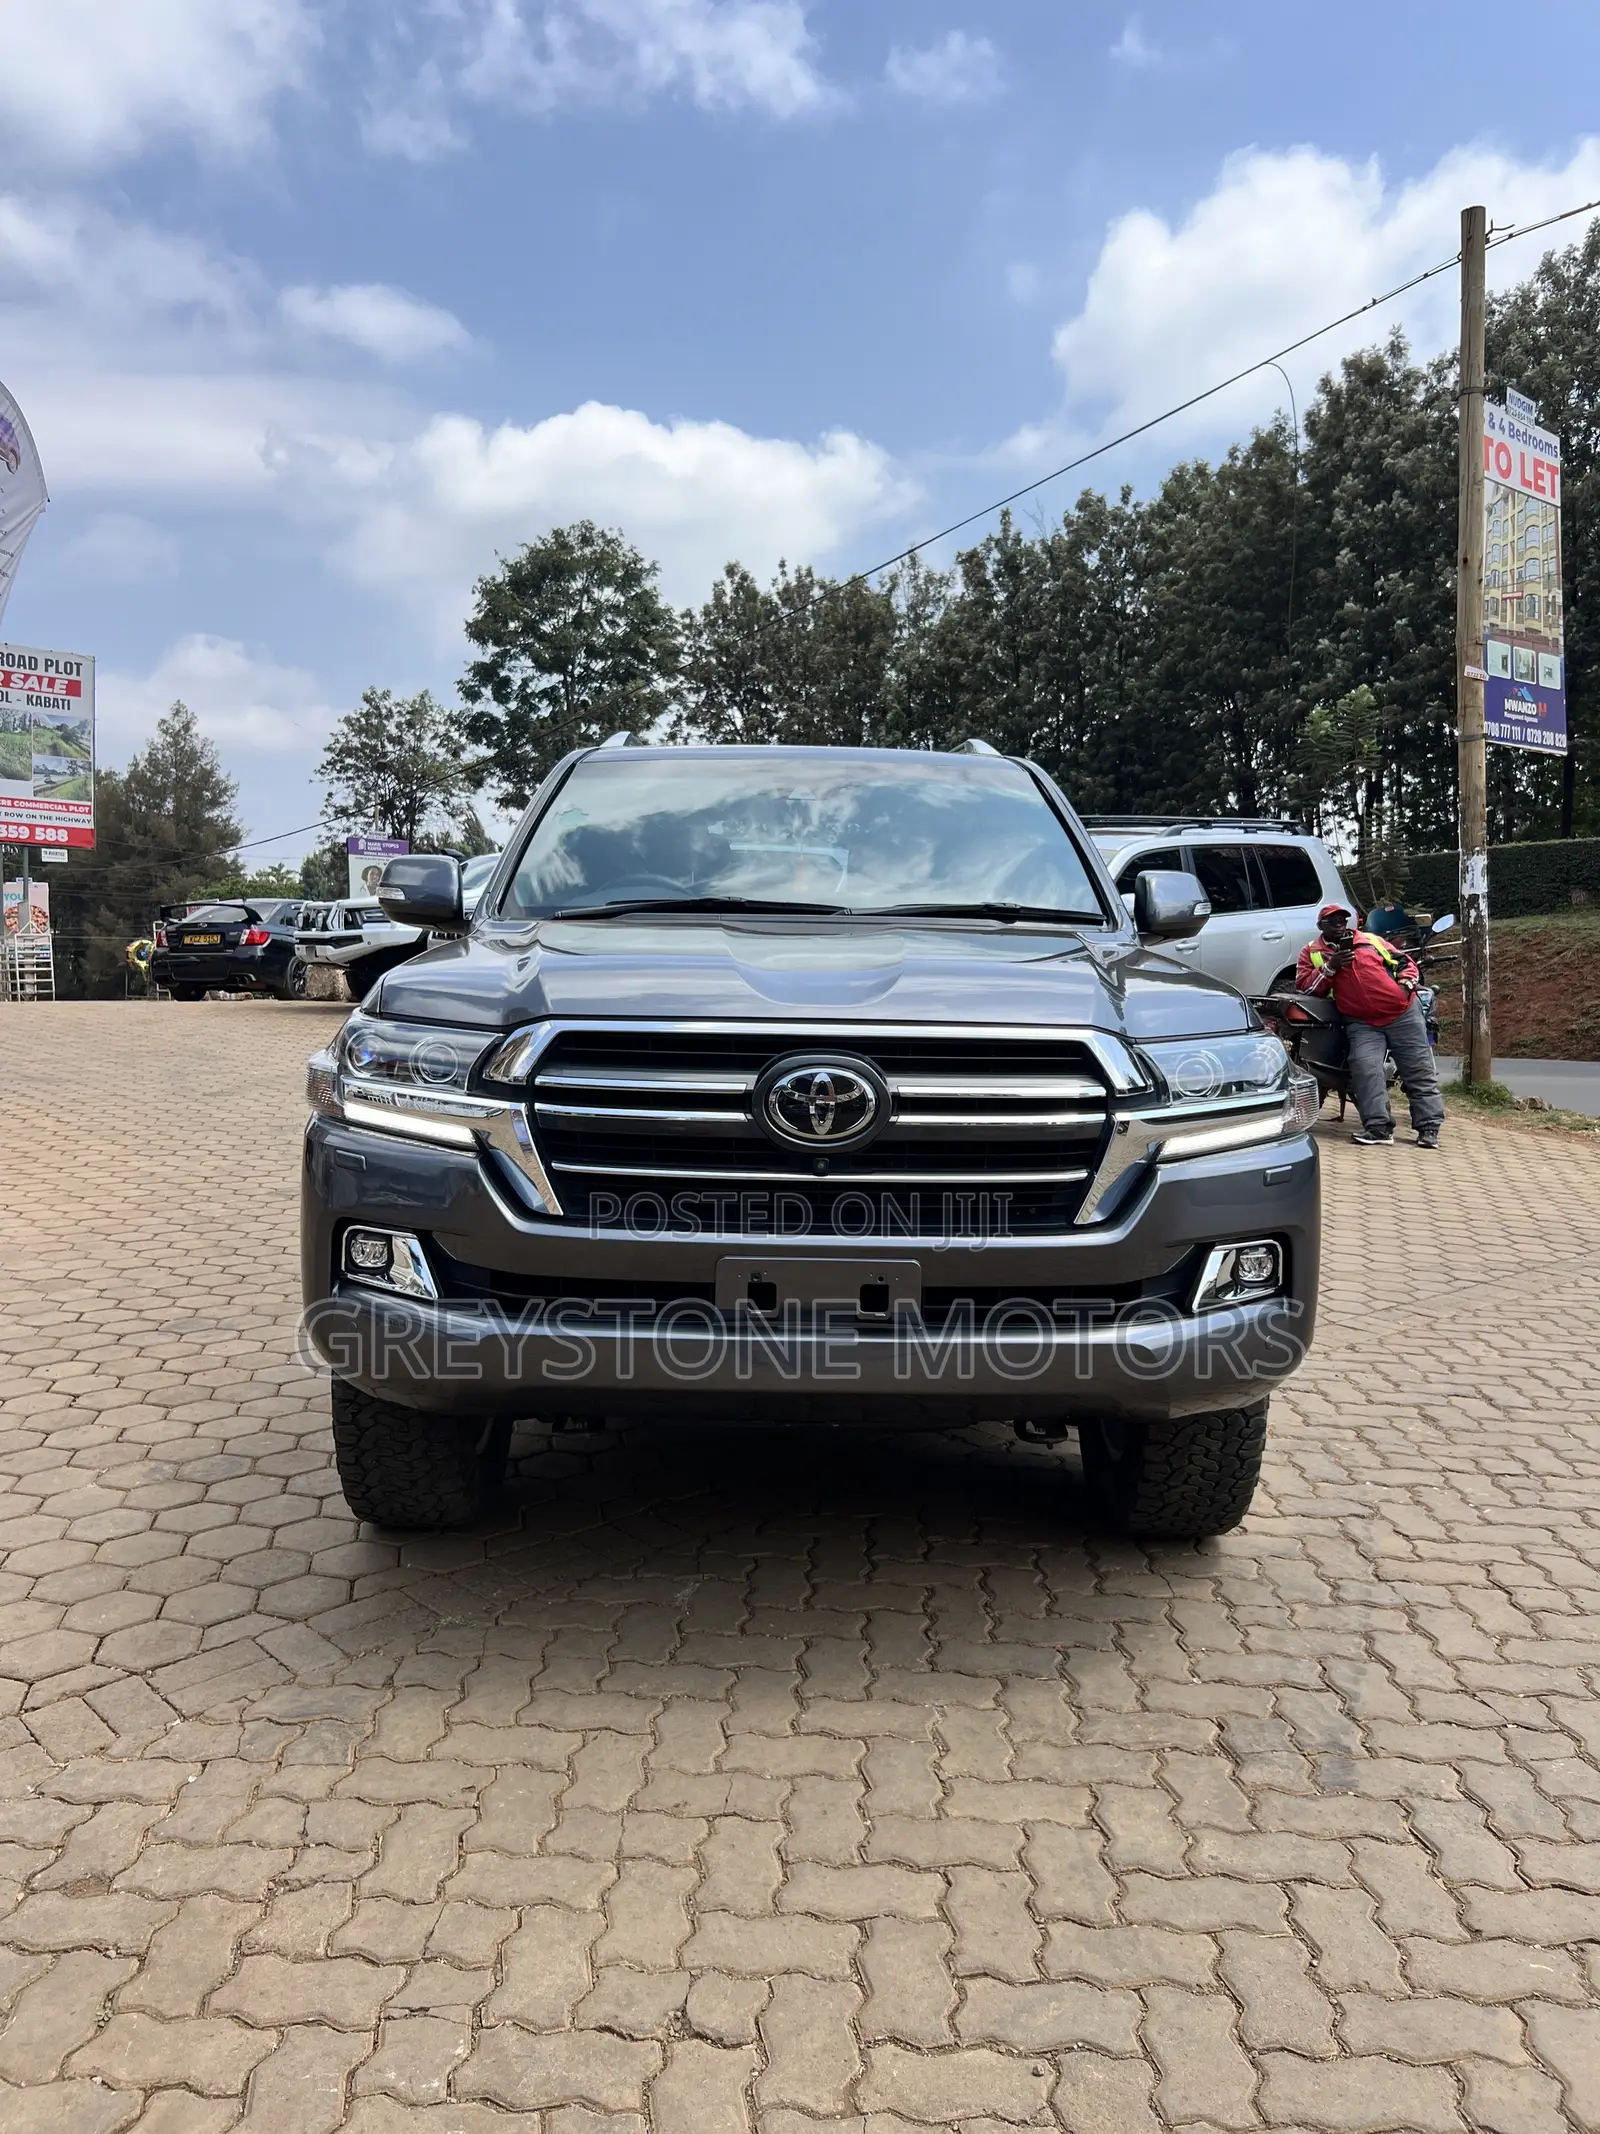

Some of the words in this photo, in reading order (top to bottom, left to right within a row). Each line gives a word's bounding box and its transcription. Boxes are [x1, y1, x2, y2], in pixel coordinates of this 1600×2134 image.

[1499, 417, 1506, 435] 4
[1508, 421, 1559, 459] Bedrooms
[1484, 435, 1512, 480] TO
[1520, 451, 1559, 499] LET
[44, 658, 83, 677] PLOT
[9, 672, 69, 695] SALE
[26, 693, 71, 711] KABATI
[1504, 698, 1537, 716] MWANZO
[1501, 724, 1510, 739] 777
[1512, 725, 1521, 741] 111
[1527, 728, 1541, 744] 0720
[14, 800, 68, 812] COMMERCIAL
[69, 805, 90, 813] PLOT
[4, 811, 24, 819] ROW
[55, 817, 92, 825] HIGHWAY
[35, 826, 69, 843] 588
